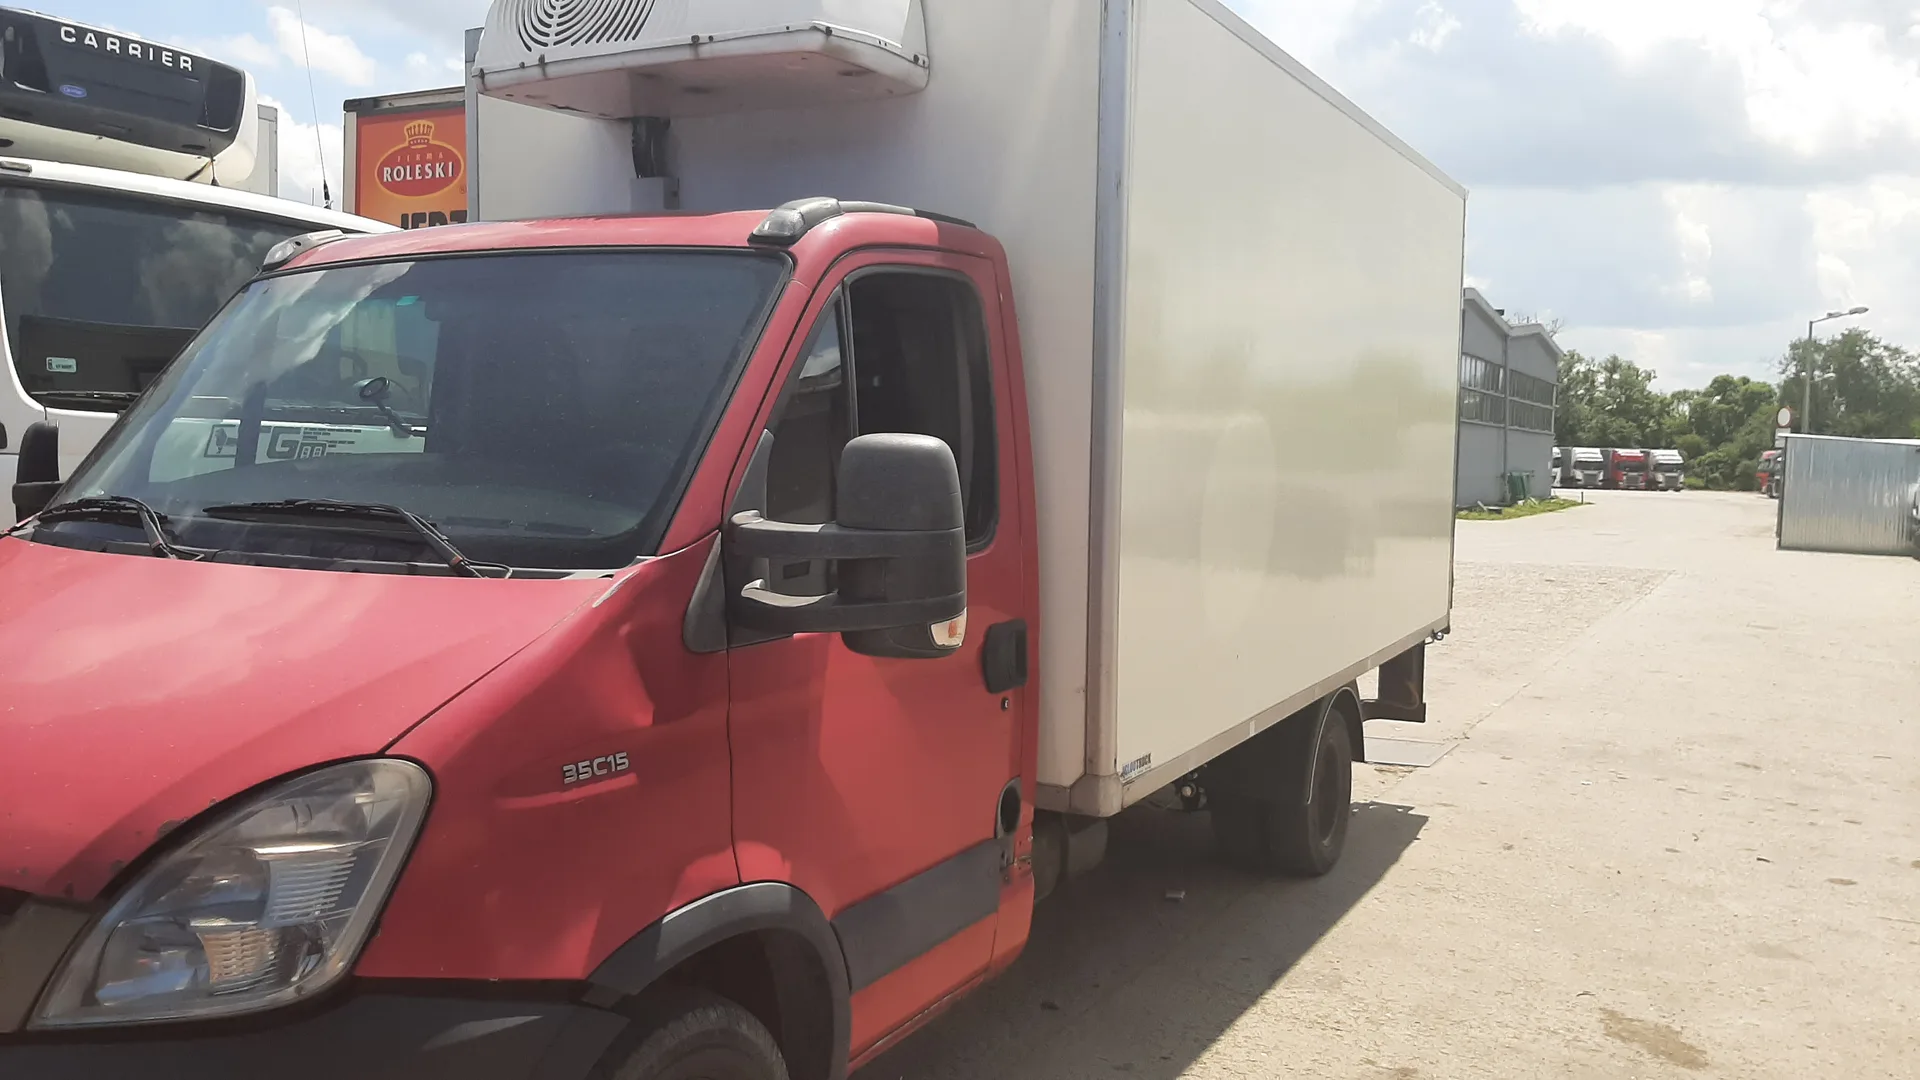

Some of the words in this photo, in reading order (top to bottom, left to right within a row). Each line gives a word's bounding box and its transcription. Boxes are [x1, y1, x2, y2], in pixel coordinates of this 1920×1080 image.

[60, 26, 193, 72] CARRIER
[397, 151, 444, 163] FIRMA
[383, 161, 455, 182] ROLESKI
[562, 751, 630, 785] 35C15
